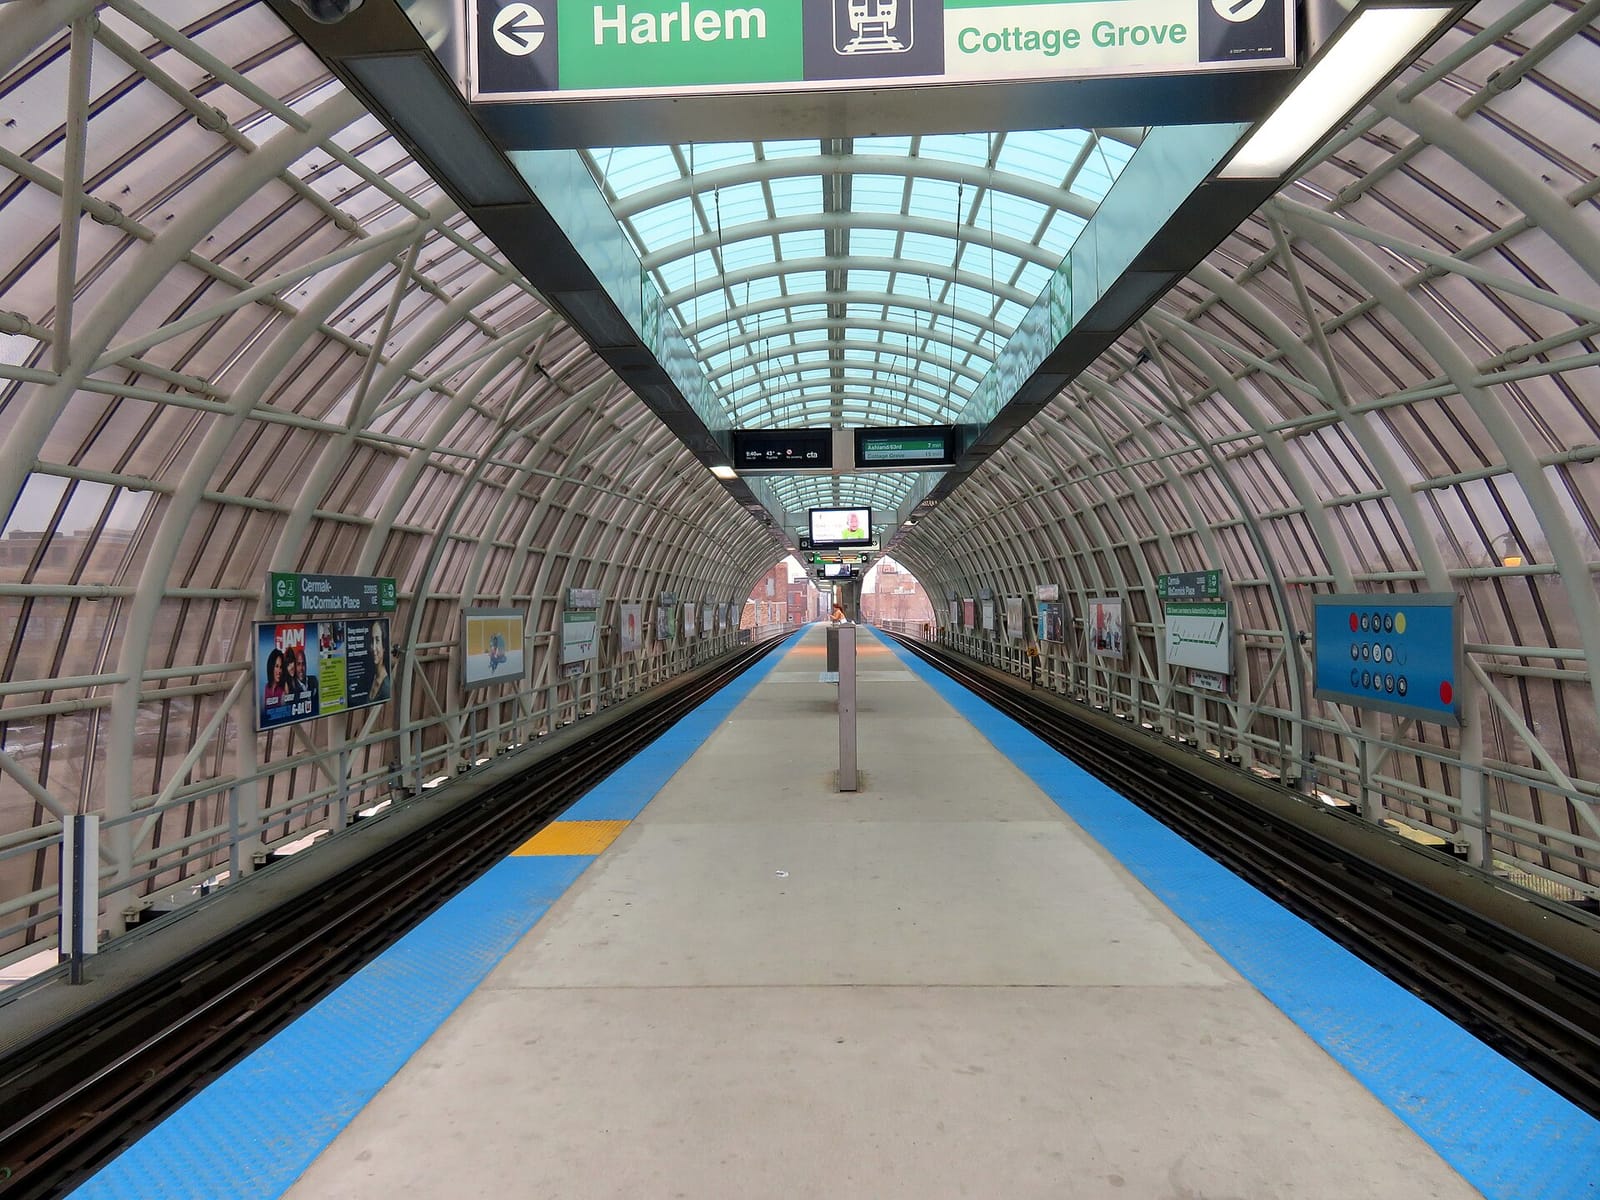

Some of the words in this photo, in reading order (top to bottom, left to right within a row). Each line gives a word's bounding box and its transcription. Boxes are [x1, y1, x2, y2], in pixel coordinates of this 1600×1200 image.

[593, 1, 767, 45] Harlem
[957, 26, 1081, 56] Cottage
[1091, 20, 1188, 47] Grove
[806, 451, 818, 459] cta
[301, 578, 332, 592] Cermak-
[302, 595, 341, 609] McCormick
[343, 596, 360, 609] Place
[276, 627, 305, 653] JAM
